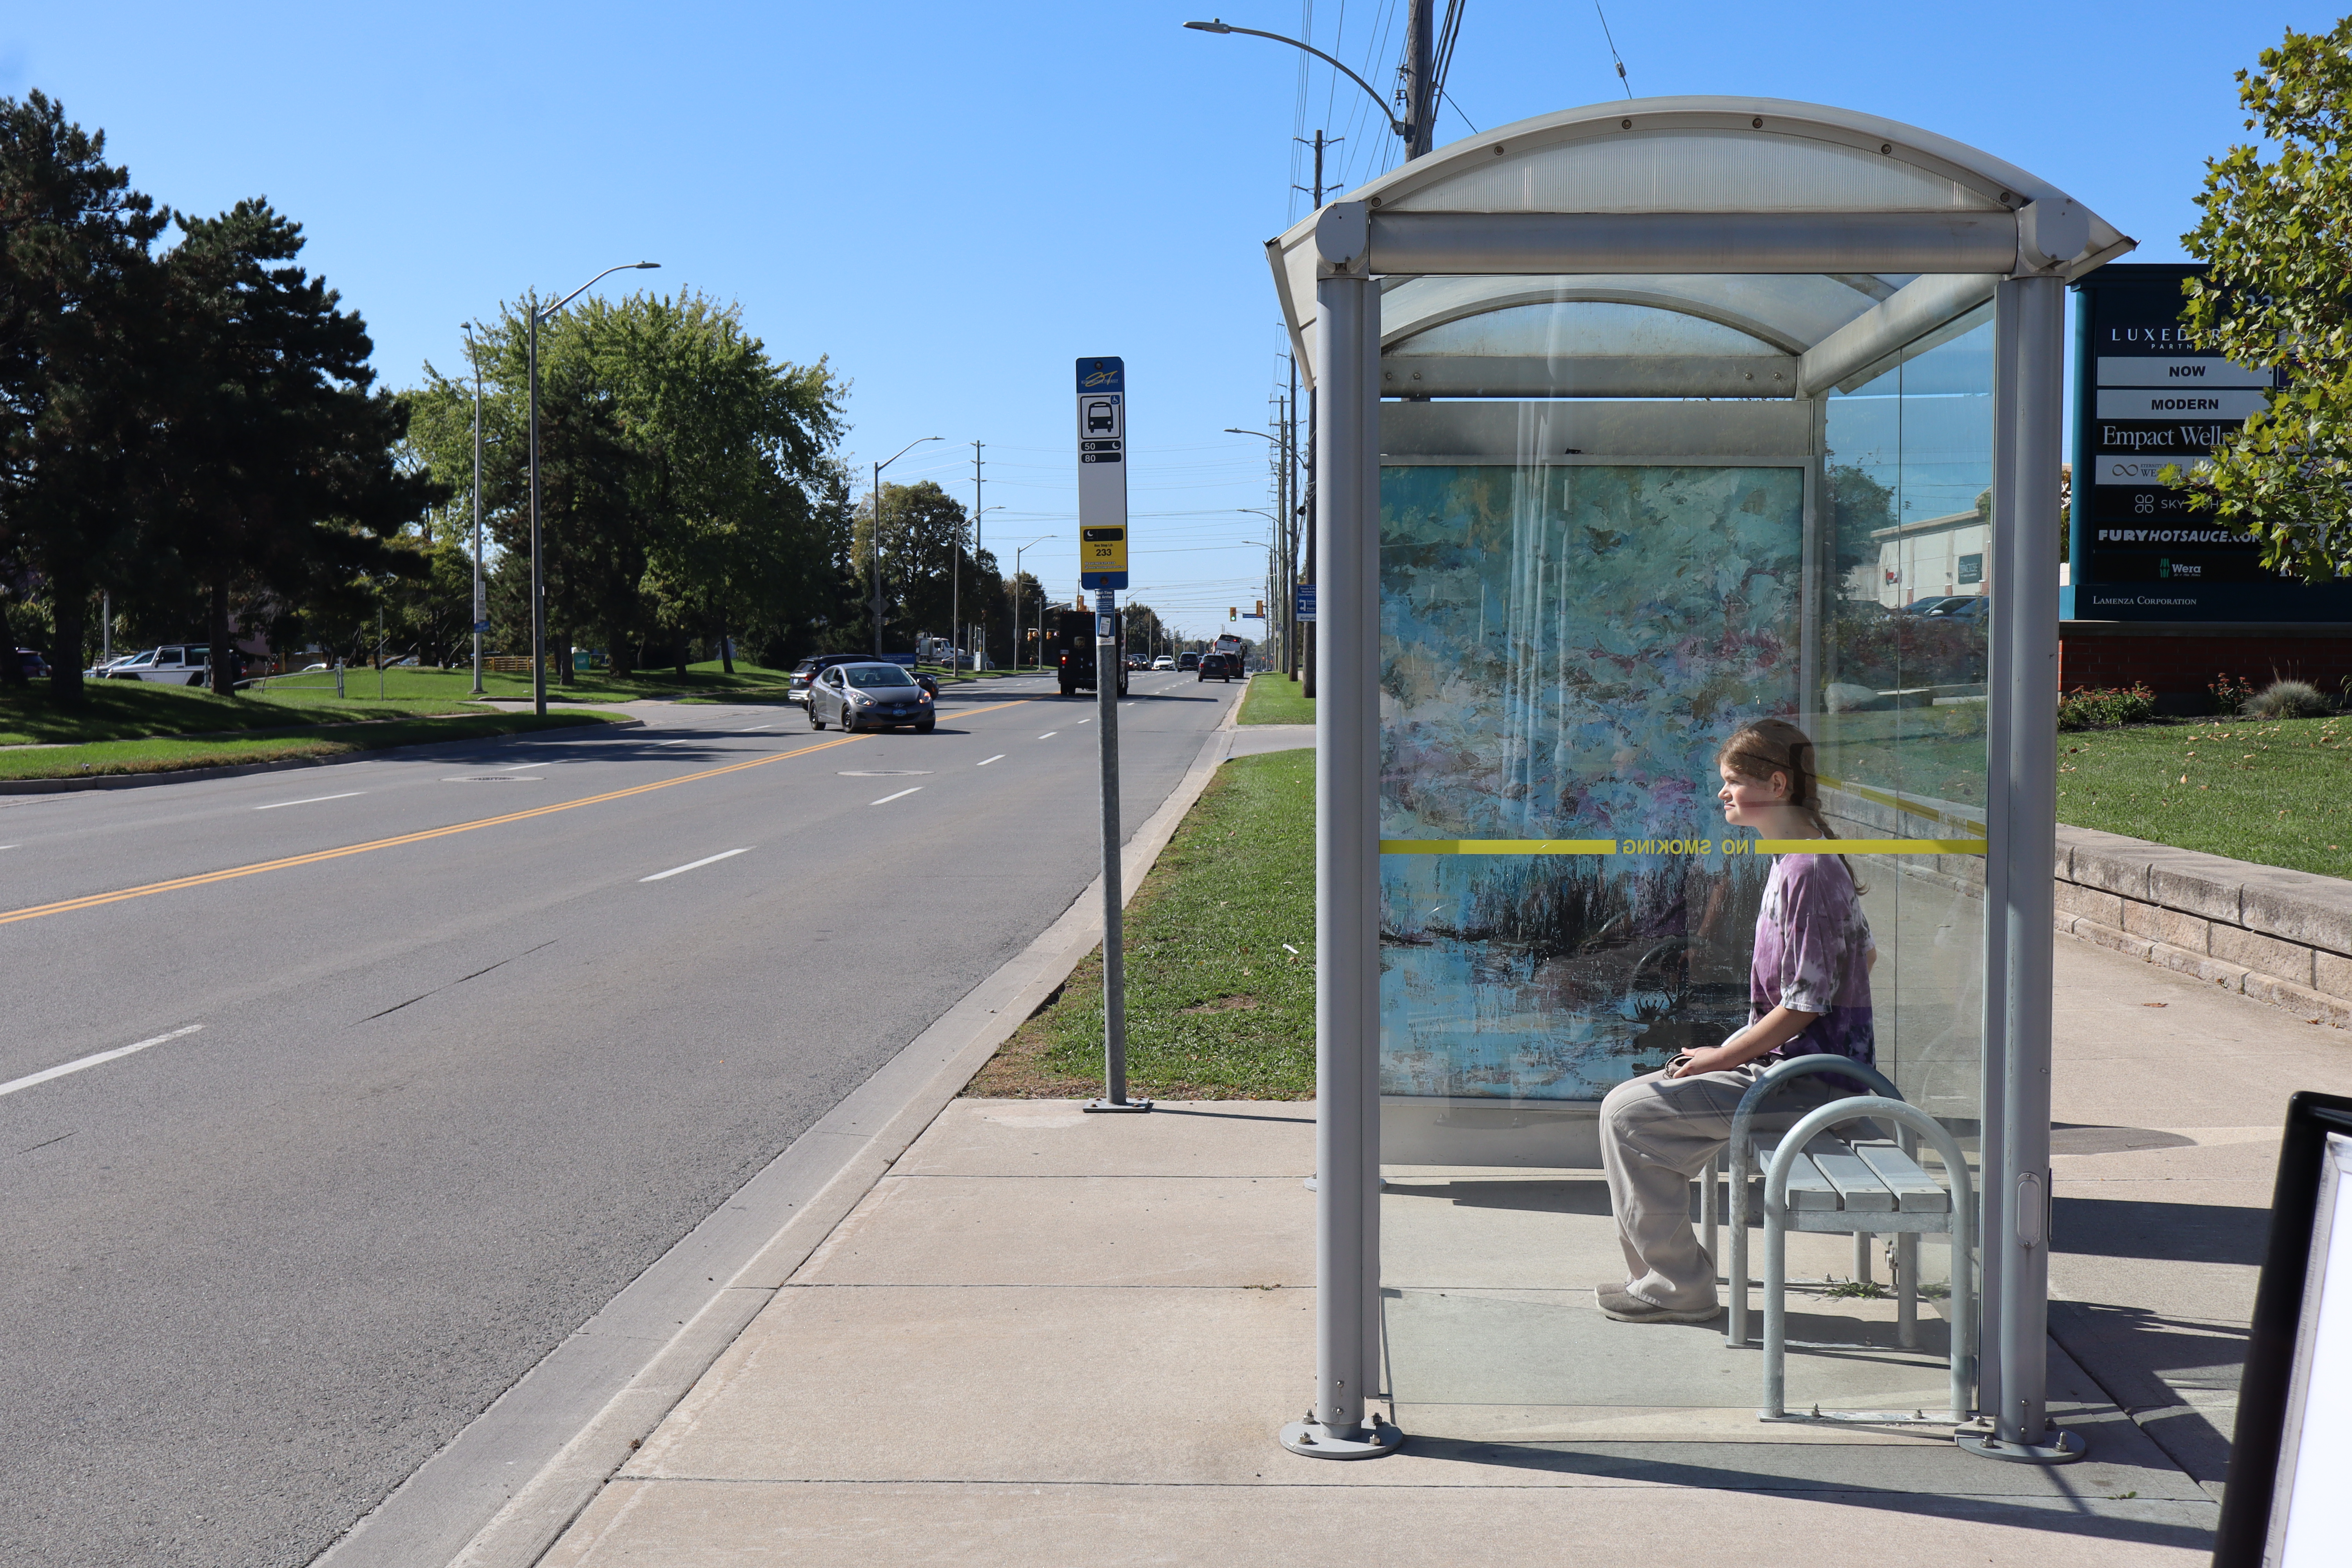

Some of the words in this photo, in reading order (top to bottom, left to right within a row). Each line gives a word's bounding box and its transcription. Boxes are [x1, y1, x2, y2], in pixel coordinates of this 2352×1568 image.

[2169, 365, 2206, 377] NOW
[2151, 399, 2219, 410] MODERN
[2102, 425, 2175, 450] Empact
[2161, 499, 2185, 509] SKY
[2172, 564, 2201, 573] Wera
